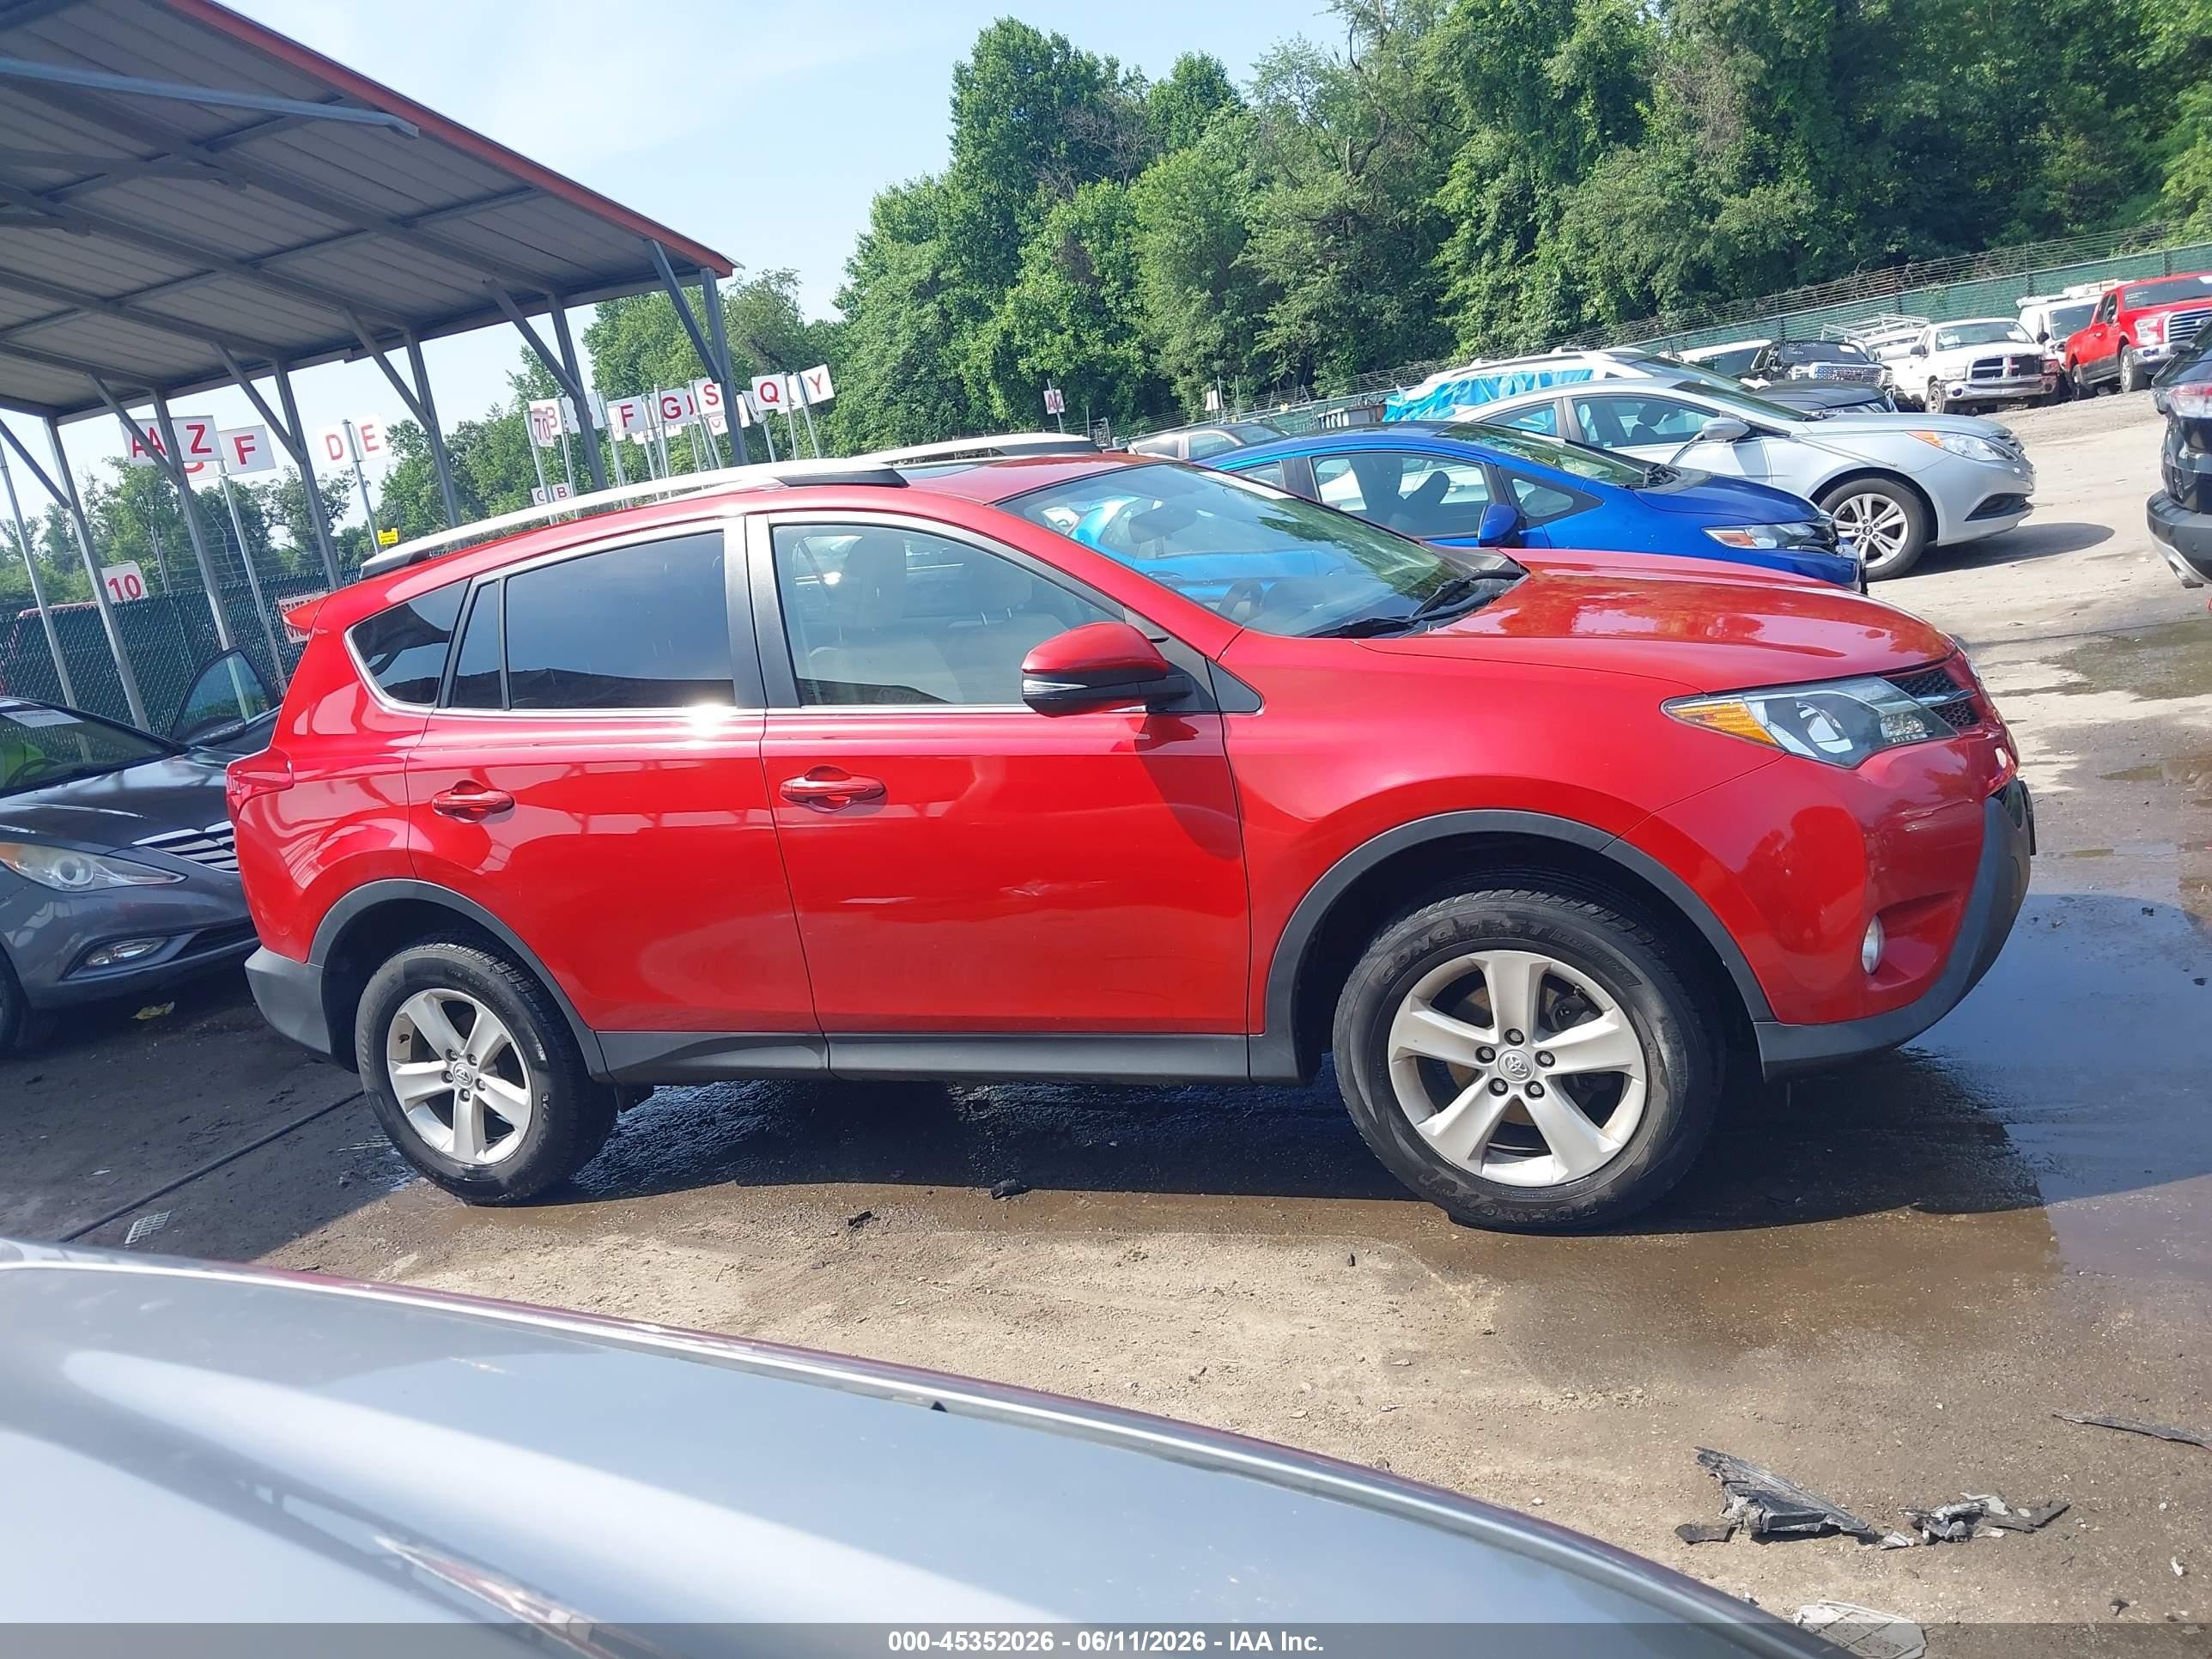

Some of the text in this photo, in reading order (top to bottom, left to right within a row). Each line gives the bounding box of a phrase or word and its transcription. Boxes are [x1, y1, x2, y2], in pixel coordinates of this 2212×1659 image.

[703, 384, 719, 405] S
[760, 381, 780, 404] Q
[808, 373, 822, 395] Y
[620, 404, 634, 428] F
[661, 396, 682, 419] G
[186, 424, 213, 453] Z
[361, 424, 380, 452] E
[534, 417, 550, 441] 70
[234, 434, 256, 465] F
[325, 434, 343, 460] D
[537, 489, 545, 501] C
[556, 486, 567, 498] B
[109, 574, 141, 600] 10
[1379, 918, 1550, 984] CONQUEST
